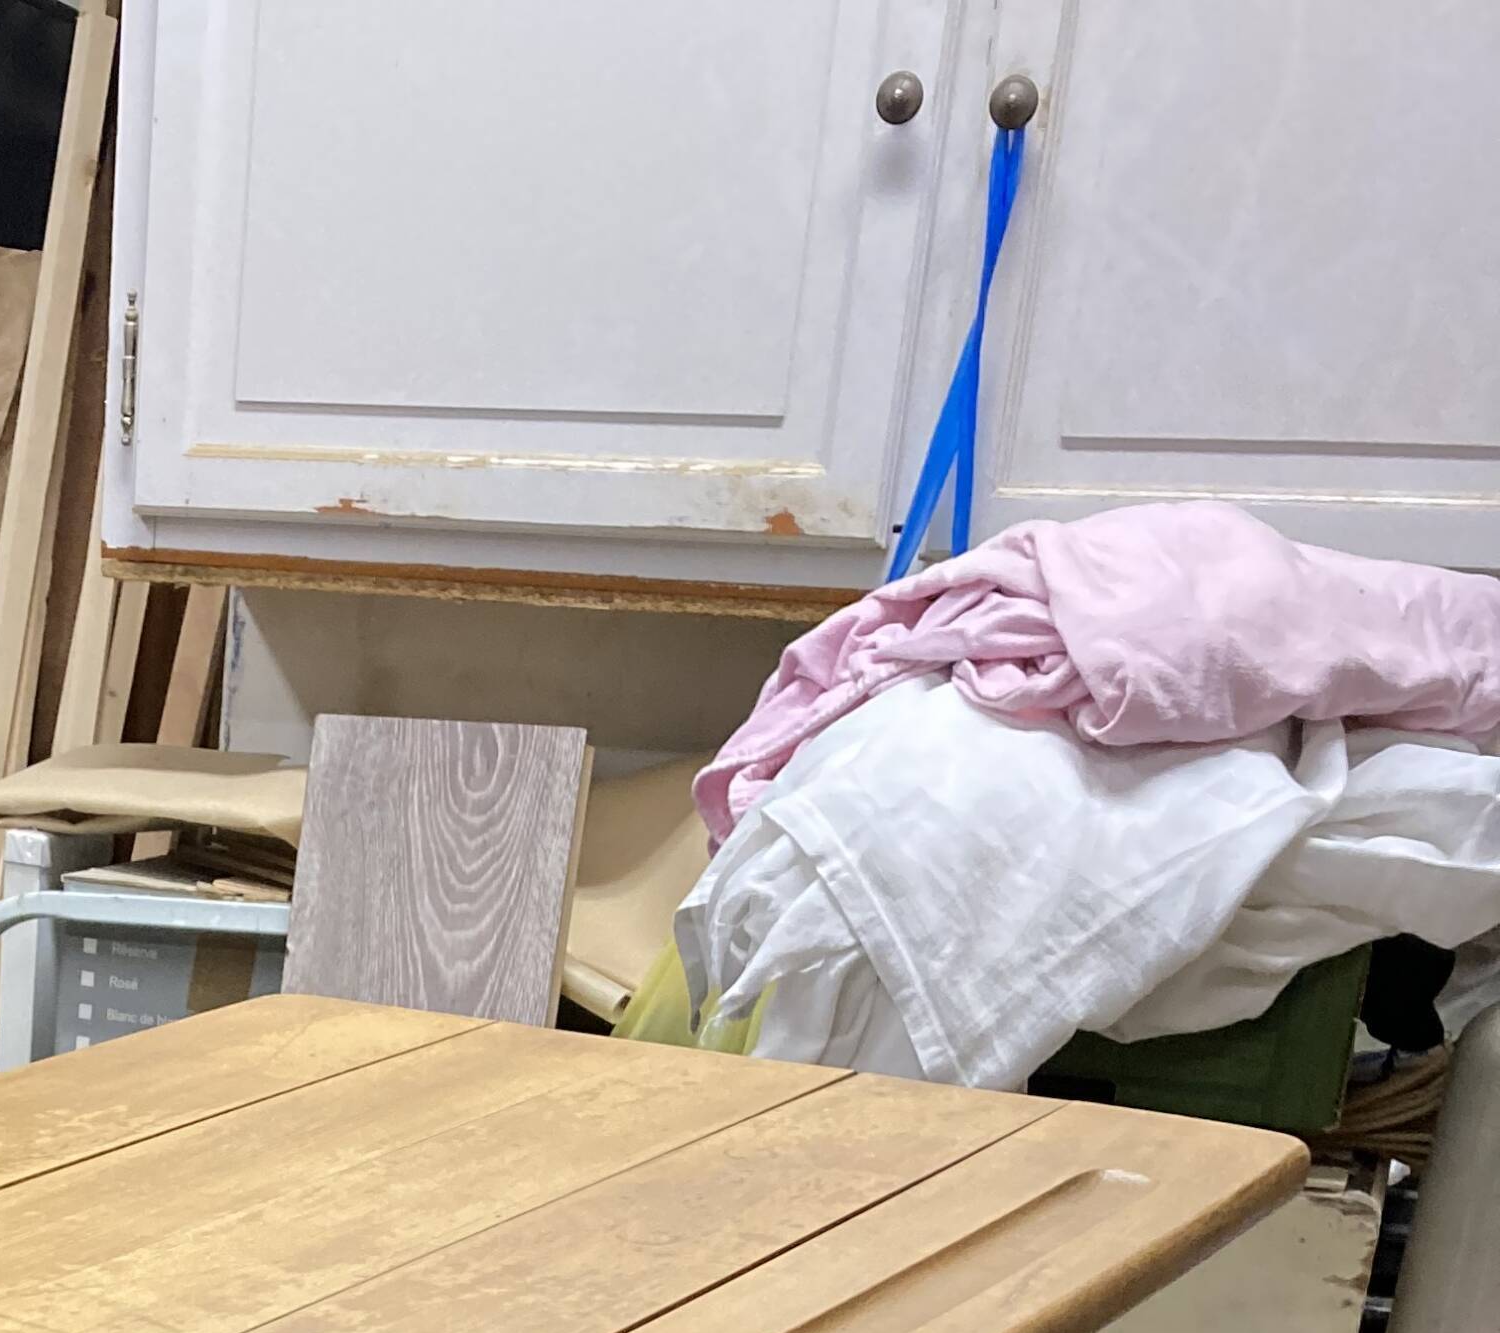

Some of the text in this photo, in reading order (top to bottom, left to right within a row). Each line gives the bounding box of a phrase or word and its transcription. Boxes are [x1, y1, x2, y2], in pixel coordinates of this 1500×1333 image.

[108, 975, 139, 991] Rosé
[106, 1007, 138, 1024] Blanc
[139, 1013, 155, 1026] de
